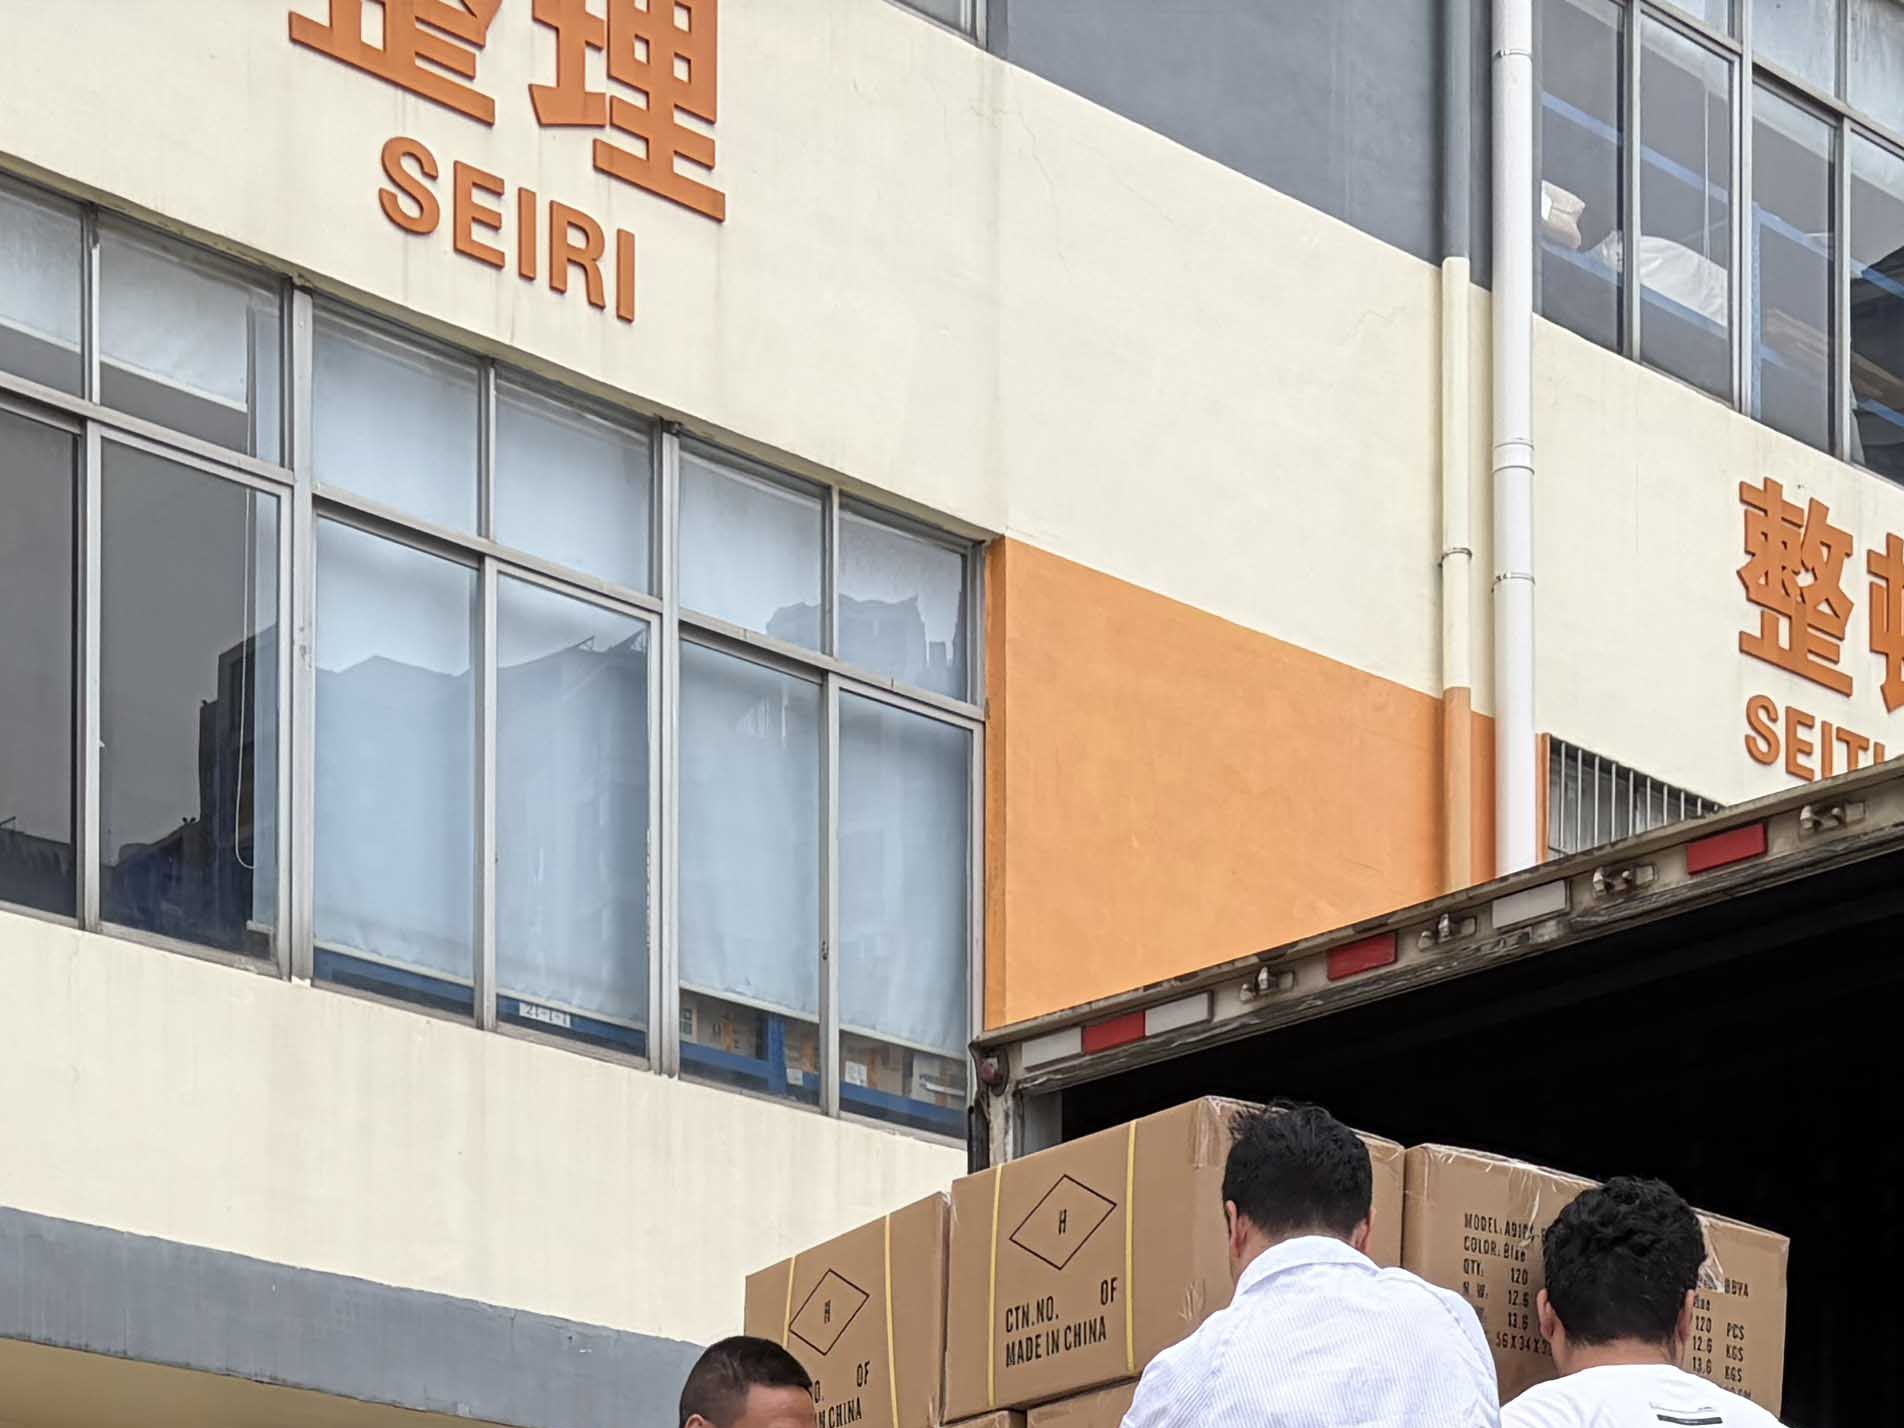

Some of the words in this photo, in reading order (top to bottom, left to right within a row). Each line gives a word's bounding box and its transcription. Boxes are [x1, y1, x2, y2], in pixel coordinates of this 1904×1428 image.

[379, 136, 635, 323] SEIRI
[1059, 1209, 1067, 1235] H
[1006, 1296, 1059, 1332] CTN.NO.
[1101, 1277, 1117, 1305] OF
[1006, 1334, 1042, 1368] MADE
[1046, 1328, 1059, 1356] IN
[1064, 1316, 1106, 1351] CHINA
[857, 1361, 870, 1387] OF
